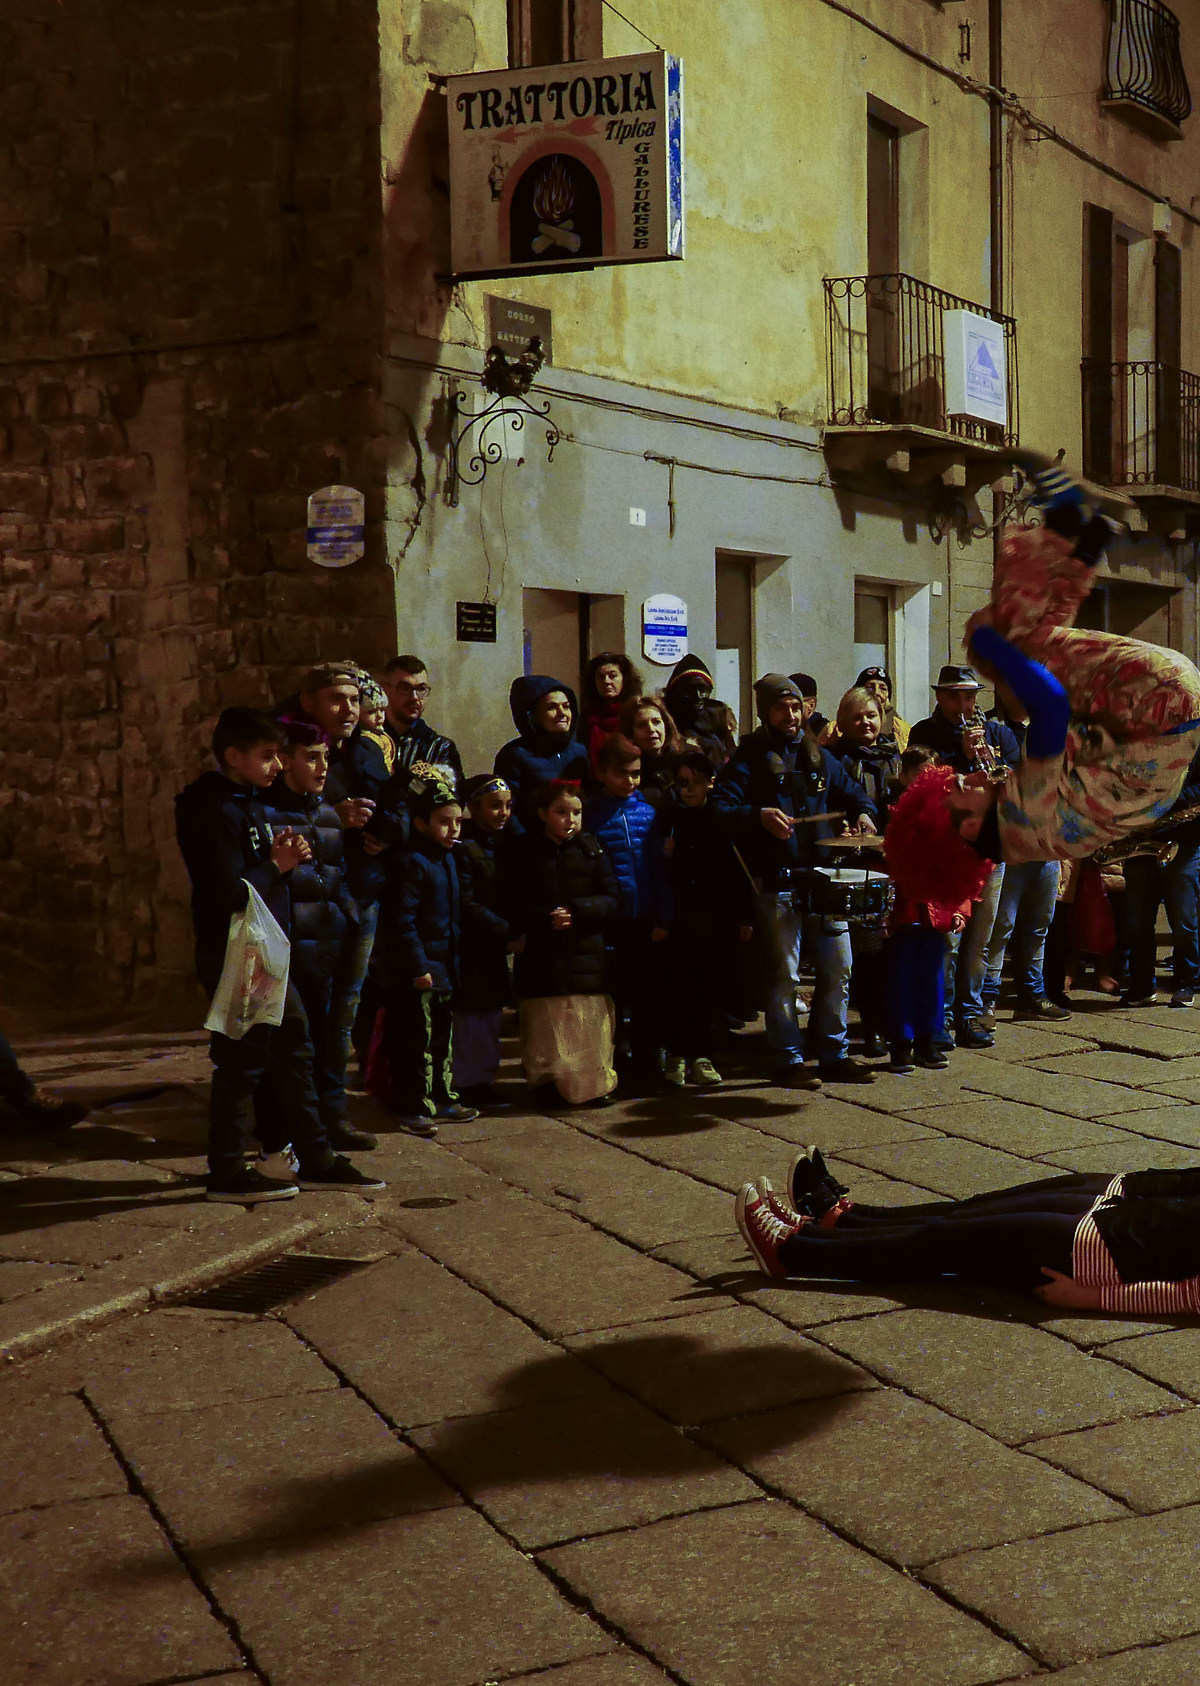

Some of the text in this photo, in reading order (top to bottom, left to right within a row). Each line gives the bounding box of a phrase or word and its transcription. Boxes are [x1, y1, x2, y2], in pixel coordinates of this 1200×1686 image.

[456, 70, 657, 131] TRATTORIA
[605, 117, 656, 145] Tipica
[631, 142, 651, 249] GALLURESE
